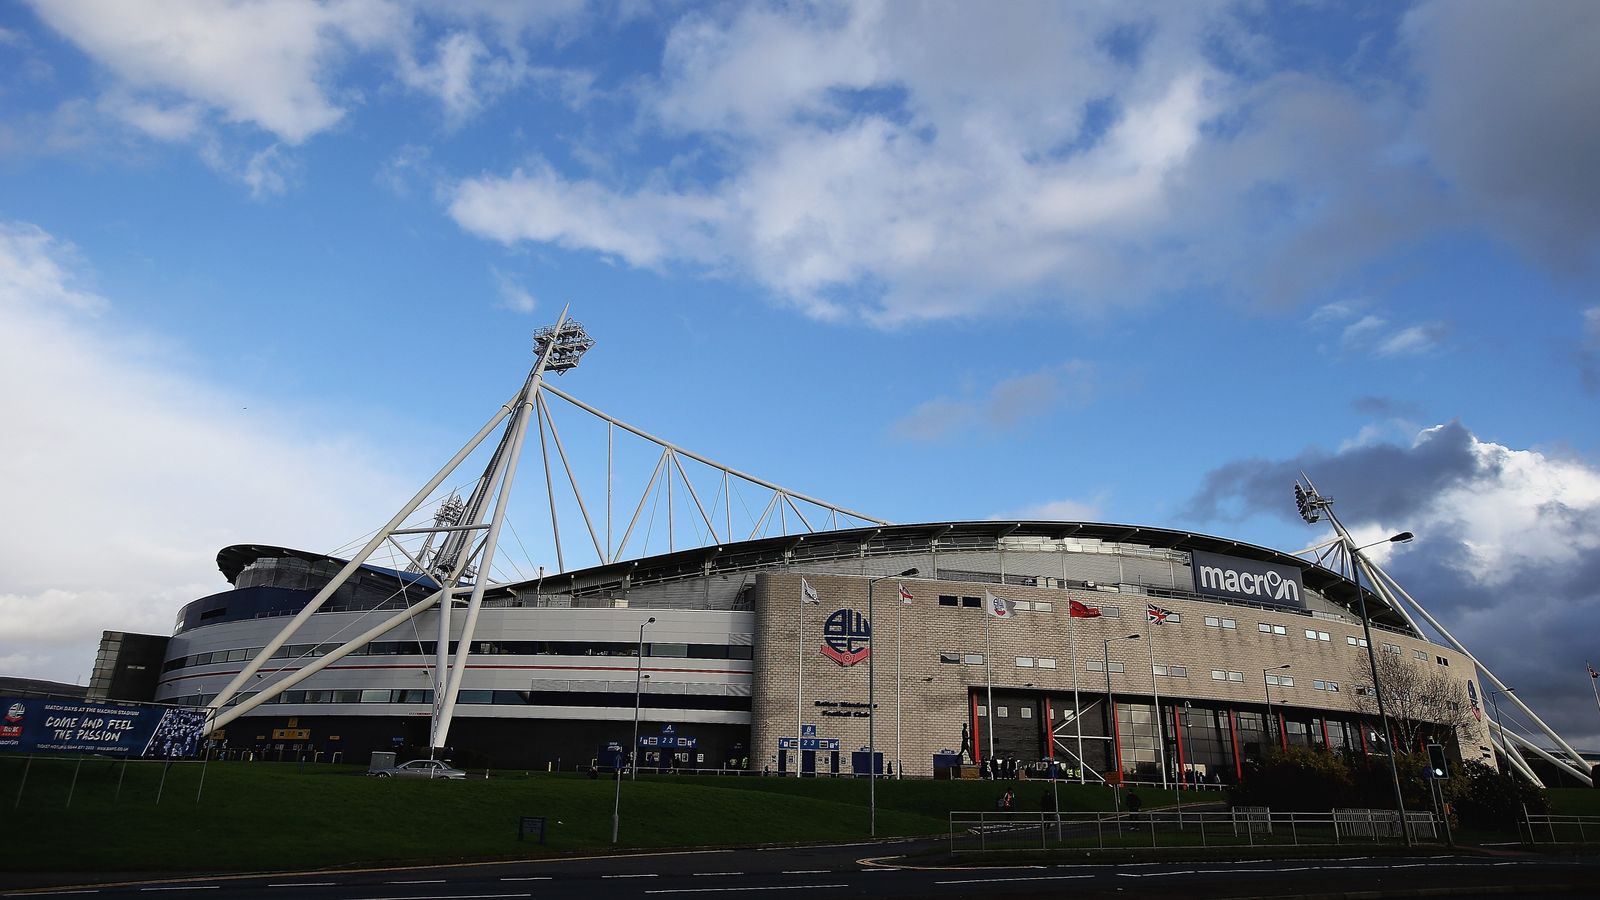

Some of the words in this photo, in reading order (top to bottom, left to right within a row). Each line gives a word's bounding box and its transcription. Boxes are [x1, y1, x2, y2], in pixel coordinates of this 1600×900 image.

[1200, 565, 1299, 601] macron
[45, 716, 79, 728] COME
[81, 717, 104, 729] AND
[106, 719, 135, 730] FEEL
[54, 728, 73, 740] THE
[76, 729, 121, 742] PASSION
